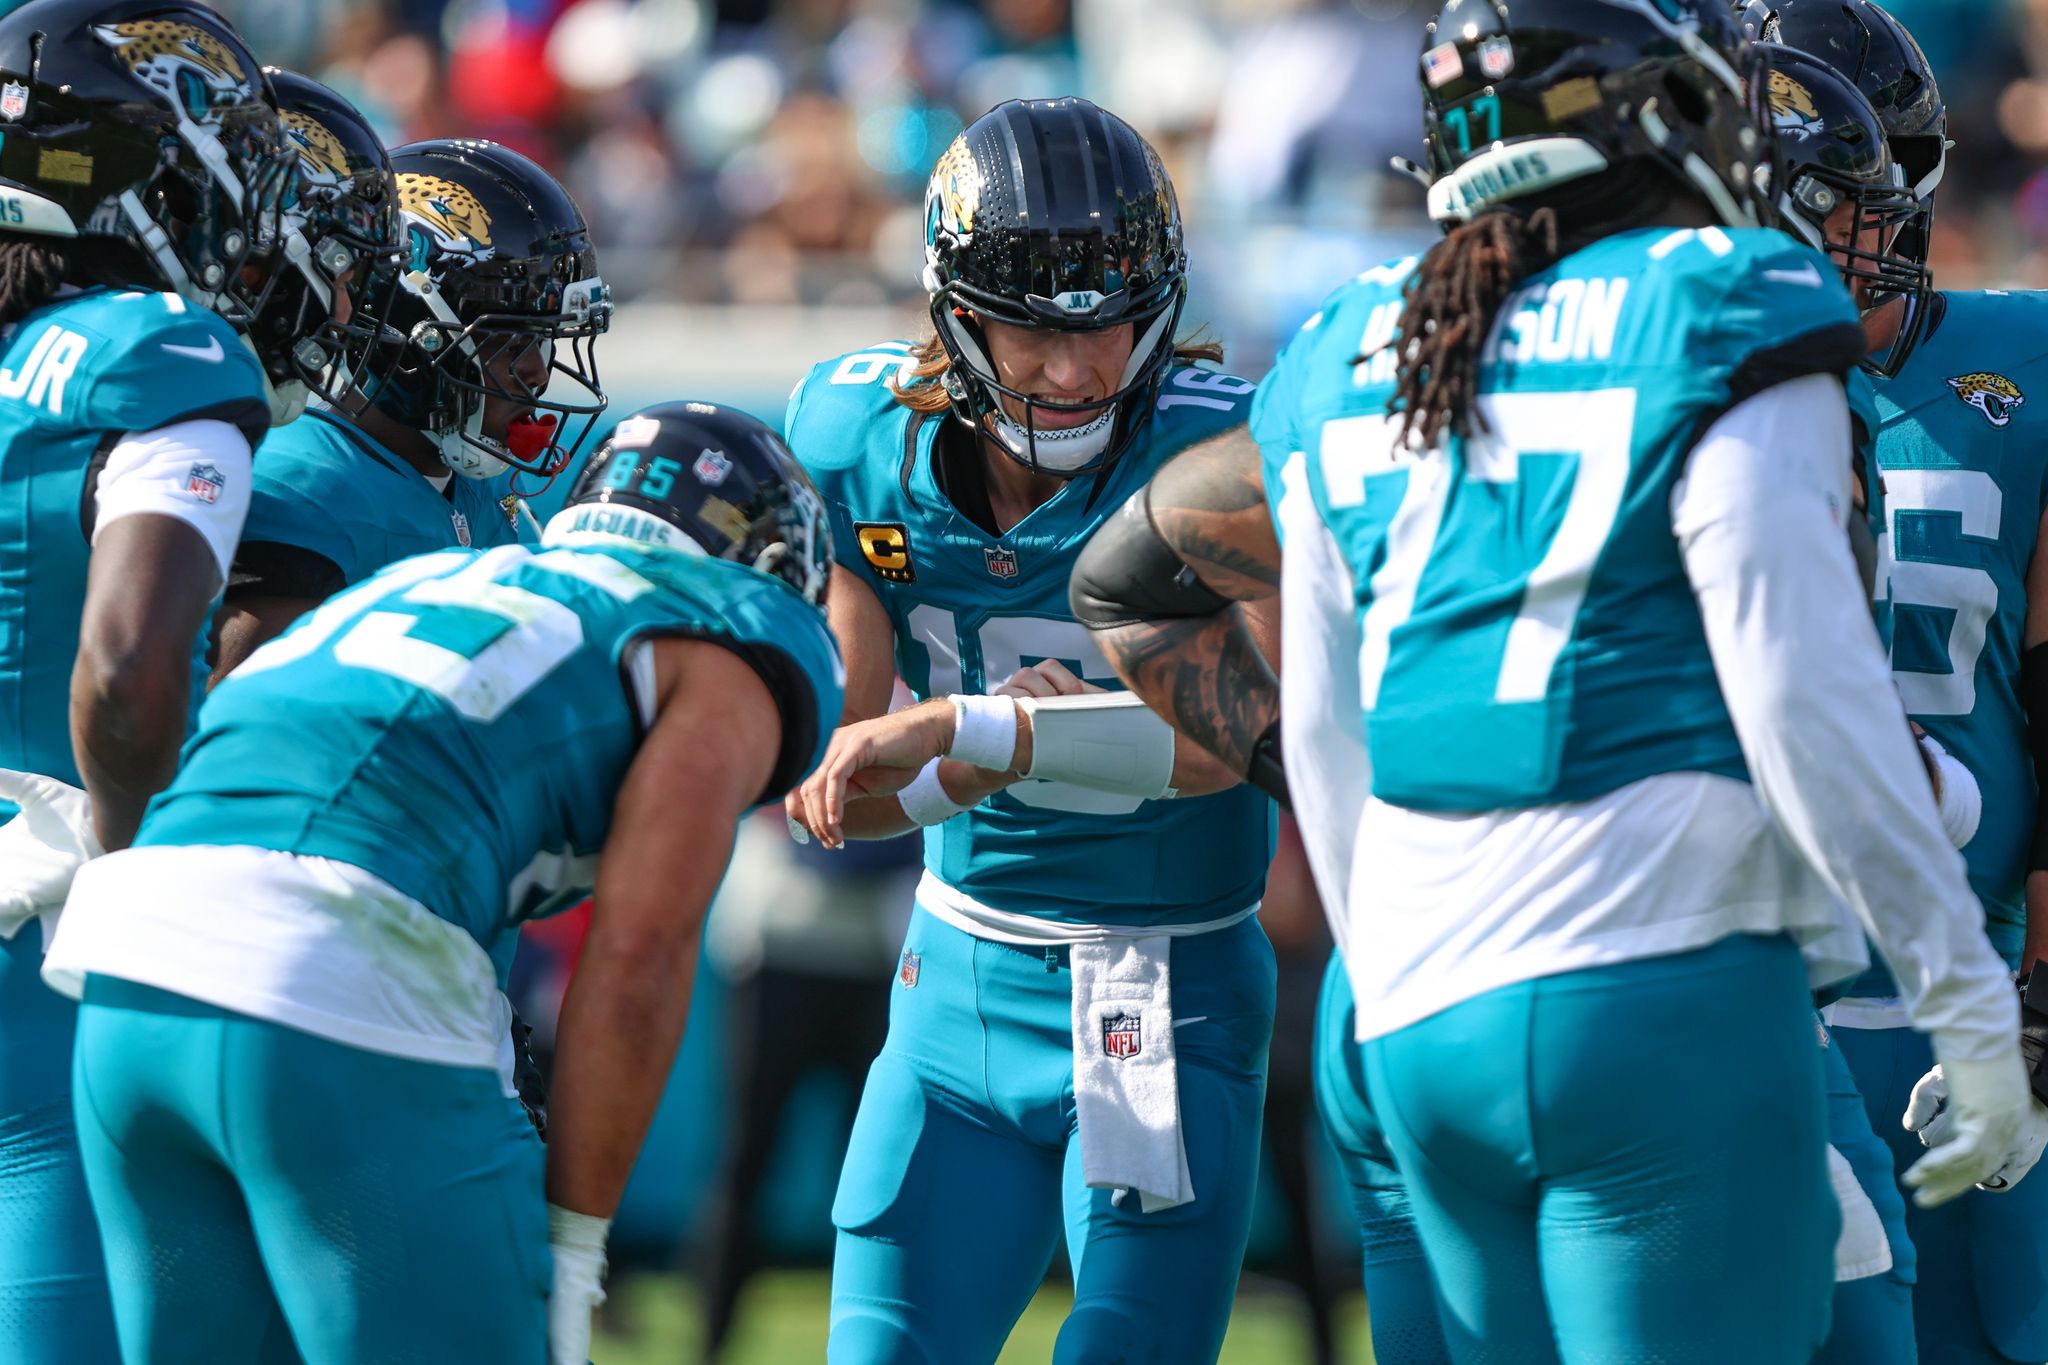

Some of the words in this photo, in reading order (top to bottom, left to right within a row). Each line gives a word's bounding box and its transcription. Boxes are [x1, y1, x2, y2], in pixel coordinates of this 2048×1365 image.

[1444, 95, 1499, 154] 77
[1068, 293, 1092, 309] JAX
[0, 324, 88, 415] JR
[1157, 367, 1257, 411] 16
[605, 451, 682, 500] 85
[859, 527, 906, 570] C
[992, 561, 1014, 575] NFL
[1320, 388, 1636, 710] 77
[1106, 1032, 1138, 1056] NFL
